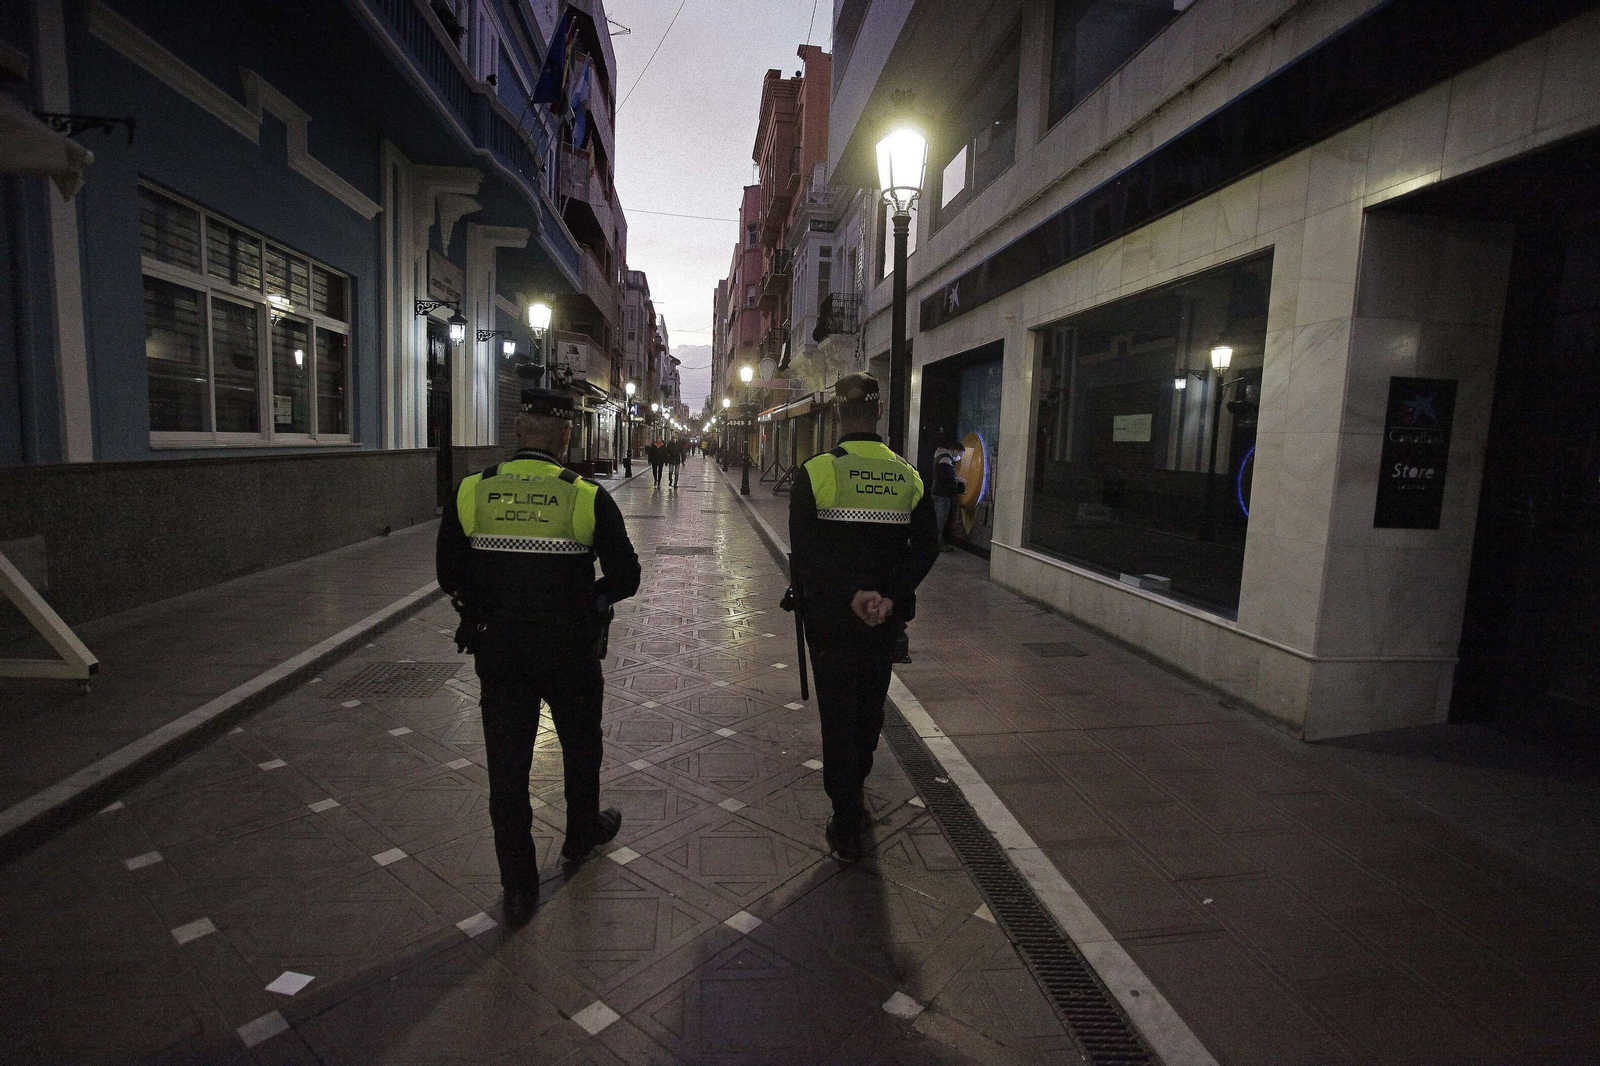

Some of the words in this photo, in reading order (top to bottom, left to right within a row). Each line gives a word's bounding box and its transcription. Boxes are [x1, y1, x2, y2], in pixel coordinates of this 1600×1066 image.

[849, 469, 906, 483] POLICIA
[1391, 462, 1435, 479] Store
[855, 483, 898, 496] LOCAL
[487, 492, 559, 507] POLICIA
[494, 509, 549, 523] LOCAL
